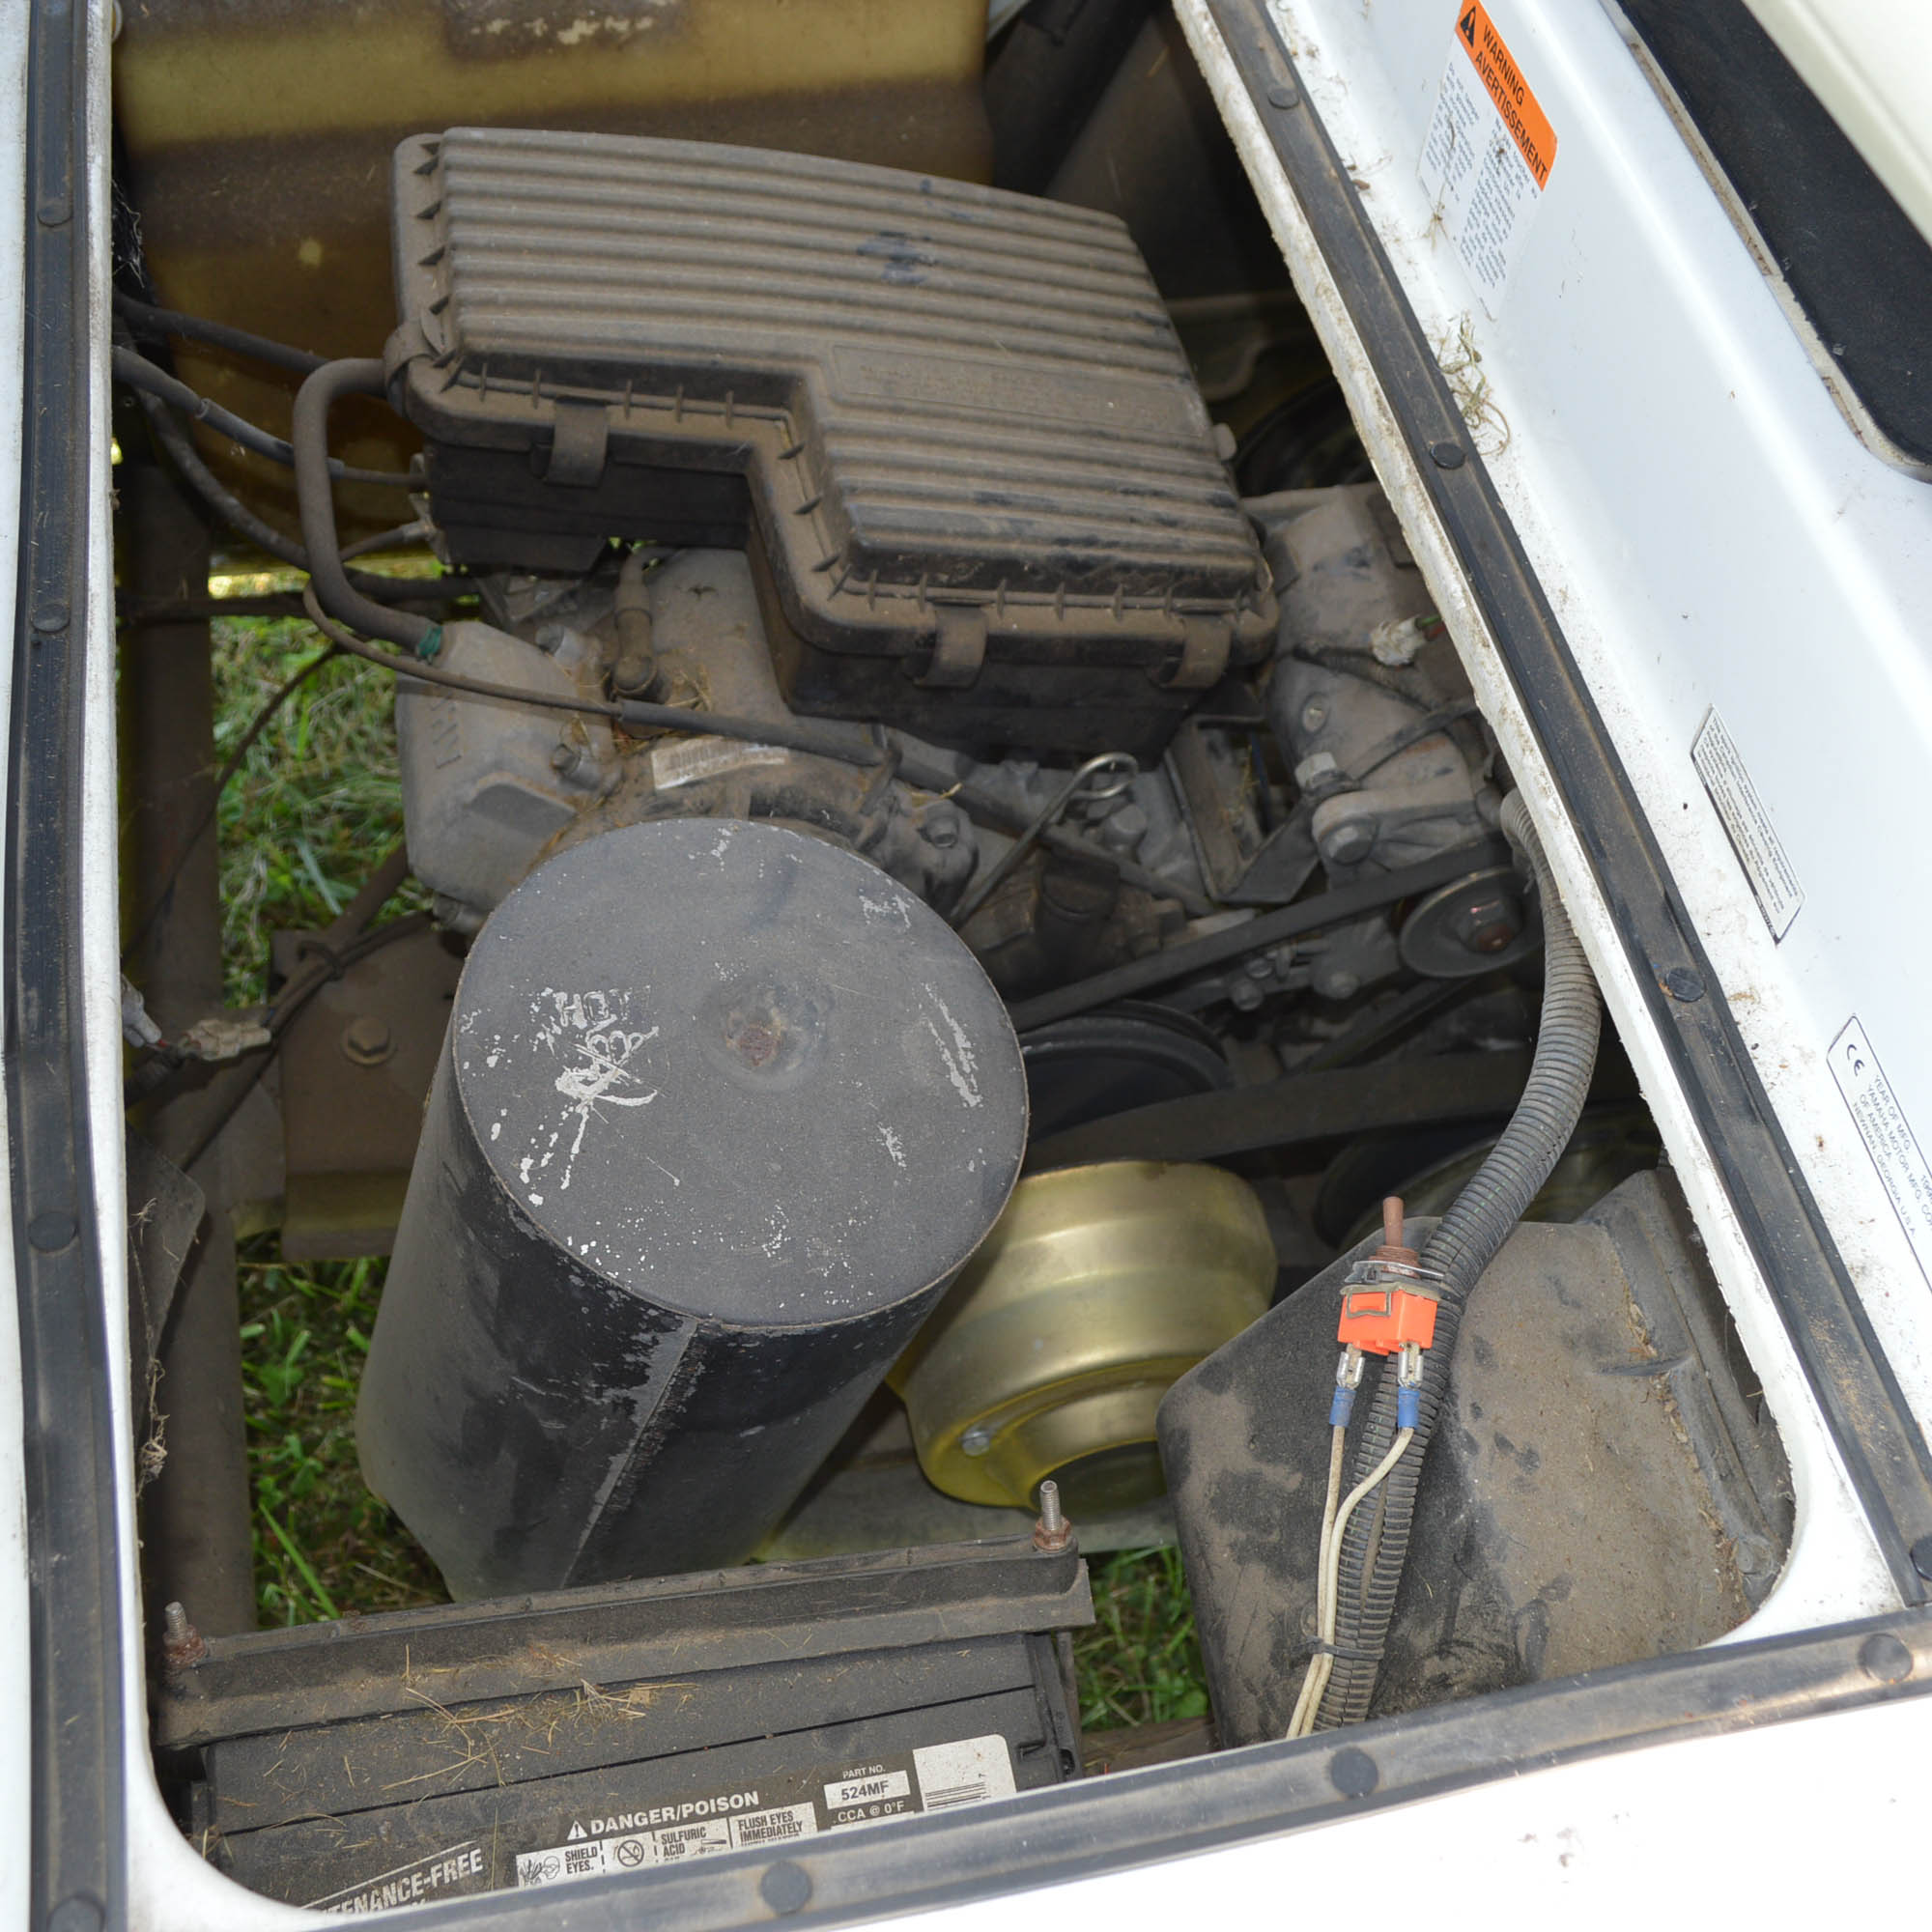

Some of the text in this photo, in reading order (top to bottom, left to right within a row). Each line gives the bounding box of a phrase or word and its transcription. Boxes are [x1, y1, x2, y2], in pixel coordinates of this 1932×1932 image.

[1483, 23, 1524, 106] WARNING
[1475, 51, 1548, 182] AVERTISSEMENT
[1847, 1044, 1864, 1076] CE
[1875, 1074, 1890, 1105] YEAR
[1888, 1106, 1899, 1121] OF
[1860, 1094, 1891, 1160] OF AMERICA
[1868, 1084, 1889, 1130] YAMAHA
[1888, 1130, 1909, 1172] MOTOR
[1920, 1204, 1932, 1232] CO
[1877, 1154, 1901, 1204] GEORGIA
[842, 1764, 886, 1779] PART NO.
[841, 1779, 890, 1802] 524MF
[590, 1791, 759, 1835] DANGER/POISON
[738, 1810, 795, 1832] FLUSH EYES
[838, 1811, 866, 1824] CCA
[870, 1806, 881, 1816] @
[661, 1827, 707, 1845] SULFURIC
[739, 1820, 804, 1844] IMMEDIATELY
[564, 1846, 598, 1862] SHIELD
[663, 1843, 686, 1858] ACID
[566, 1861, 595, 1875] EYES.
